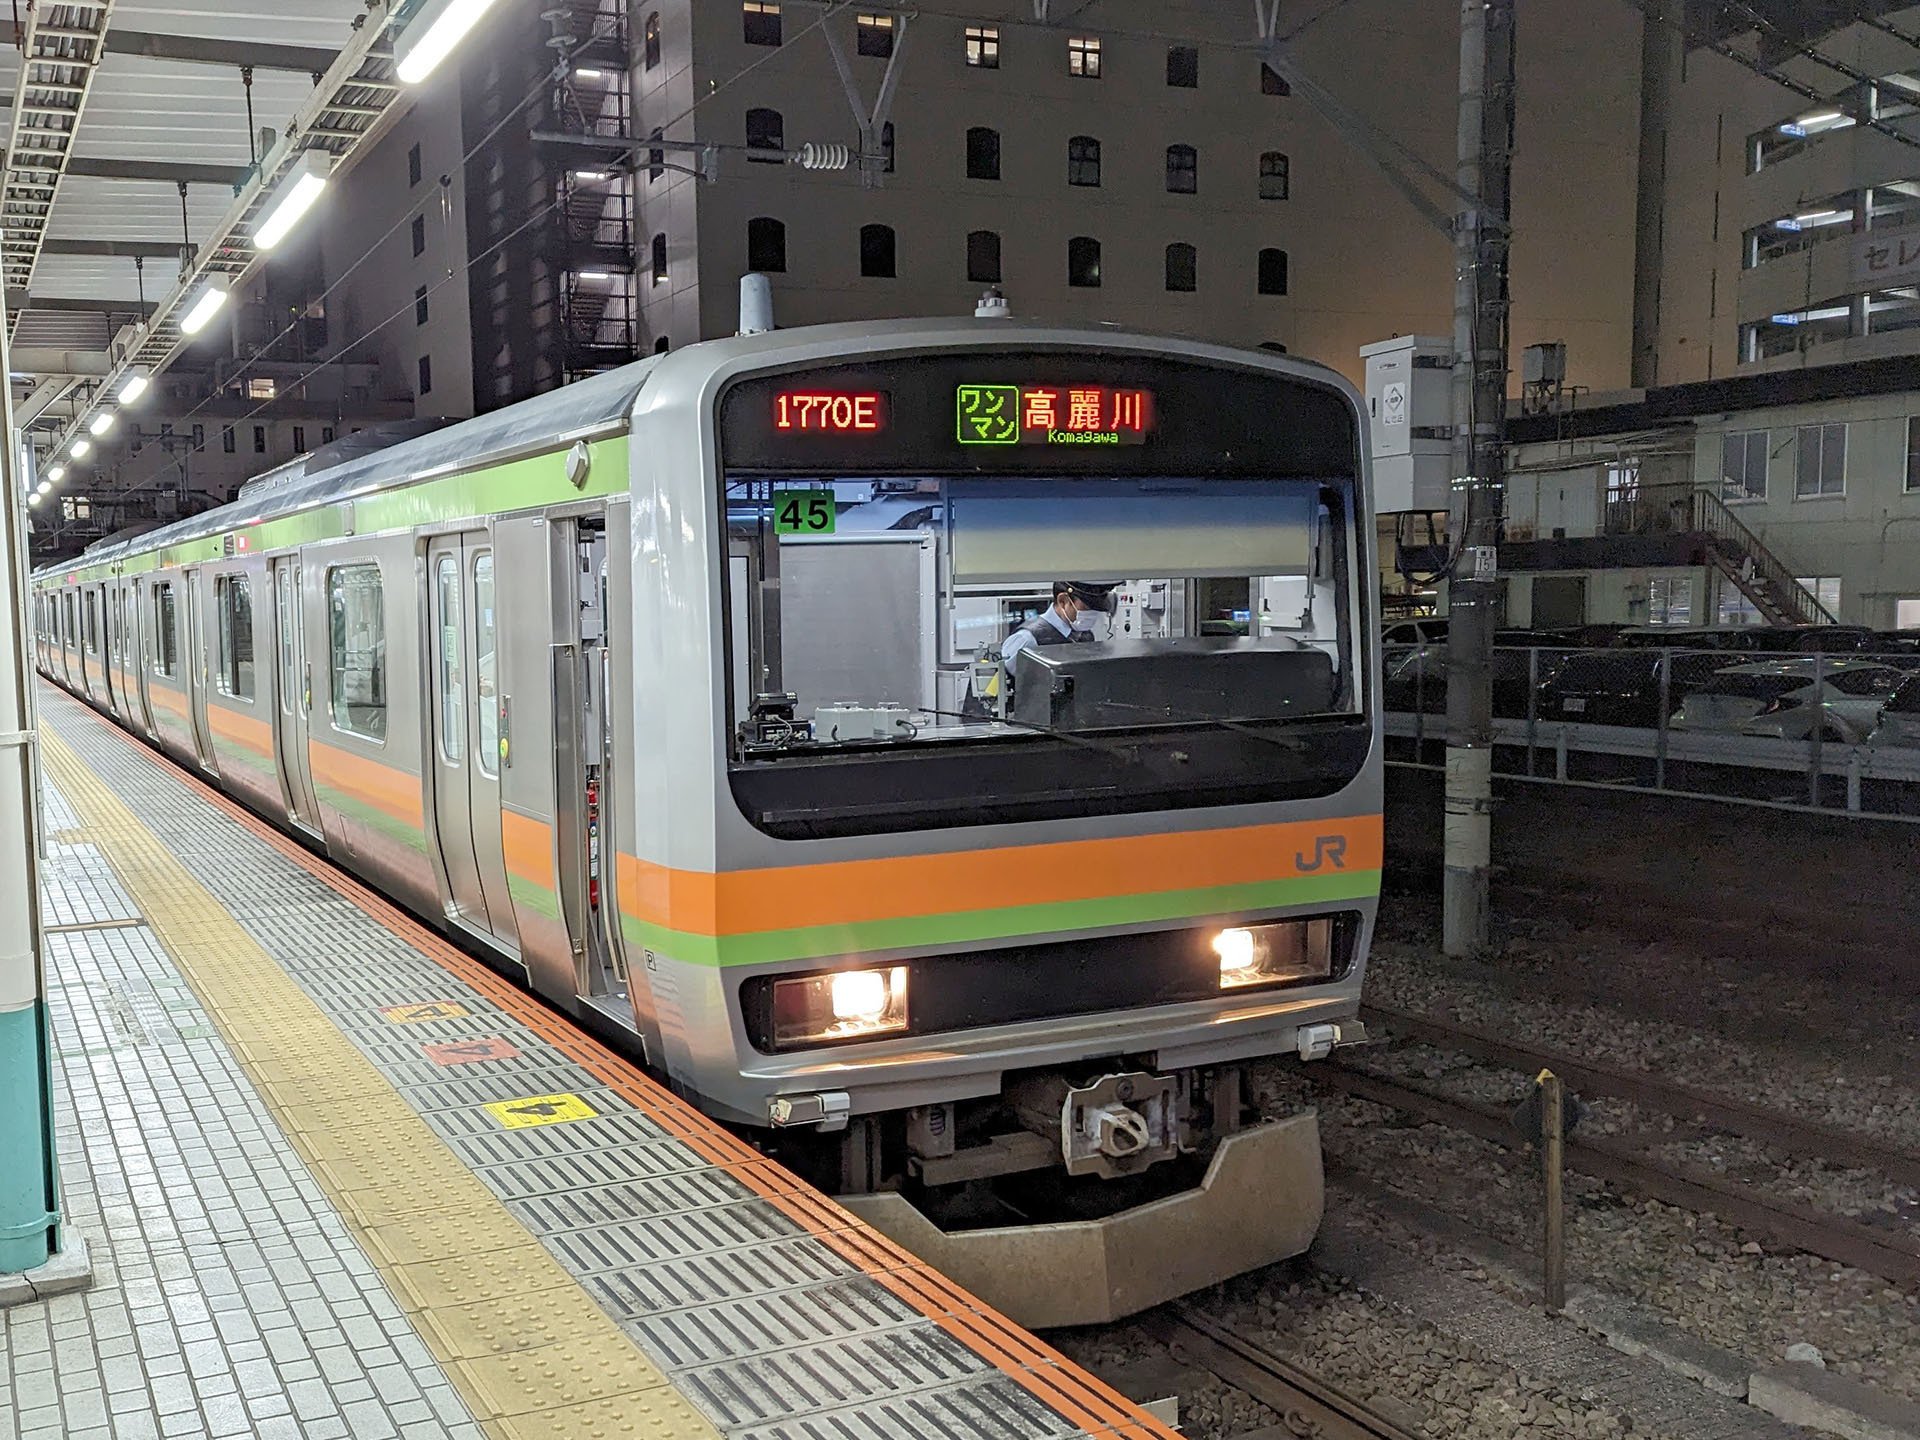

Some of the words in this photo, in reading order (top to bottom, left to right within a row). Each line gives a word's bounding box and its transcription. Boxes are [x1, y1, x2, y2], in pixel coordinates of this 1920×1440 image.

[778, 395, 877, 428] 1770E
[1024, 390, 1140, 430] 高麗川
[1048, 430, 1119, 443] Komagawa
[780, 499, 829, 530] 45
[1295, 835, 1346, 871] JR
